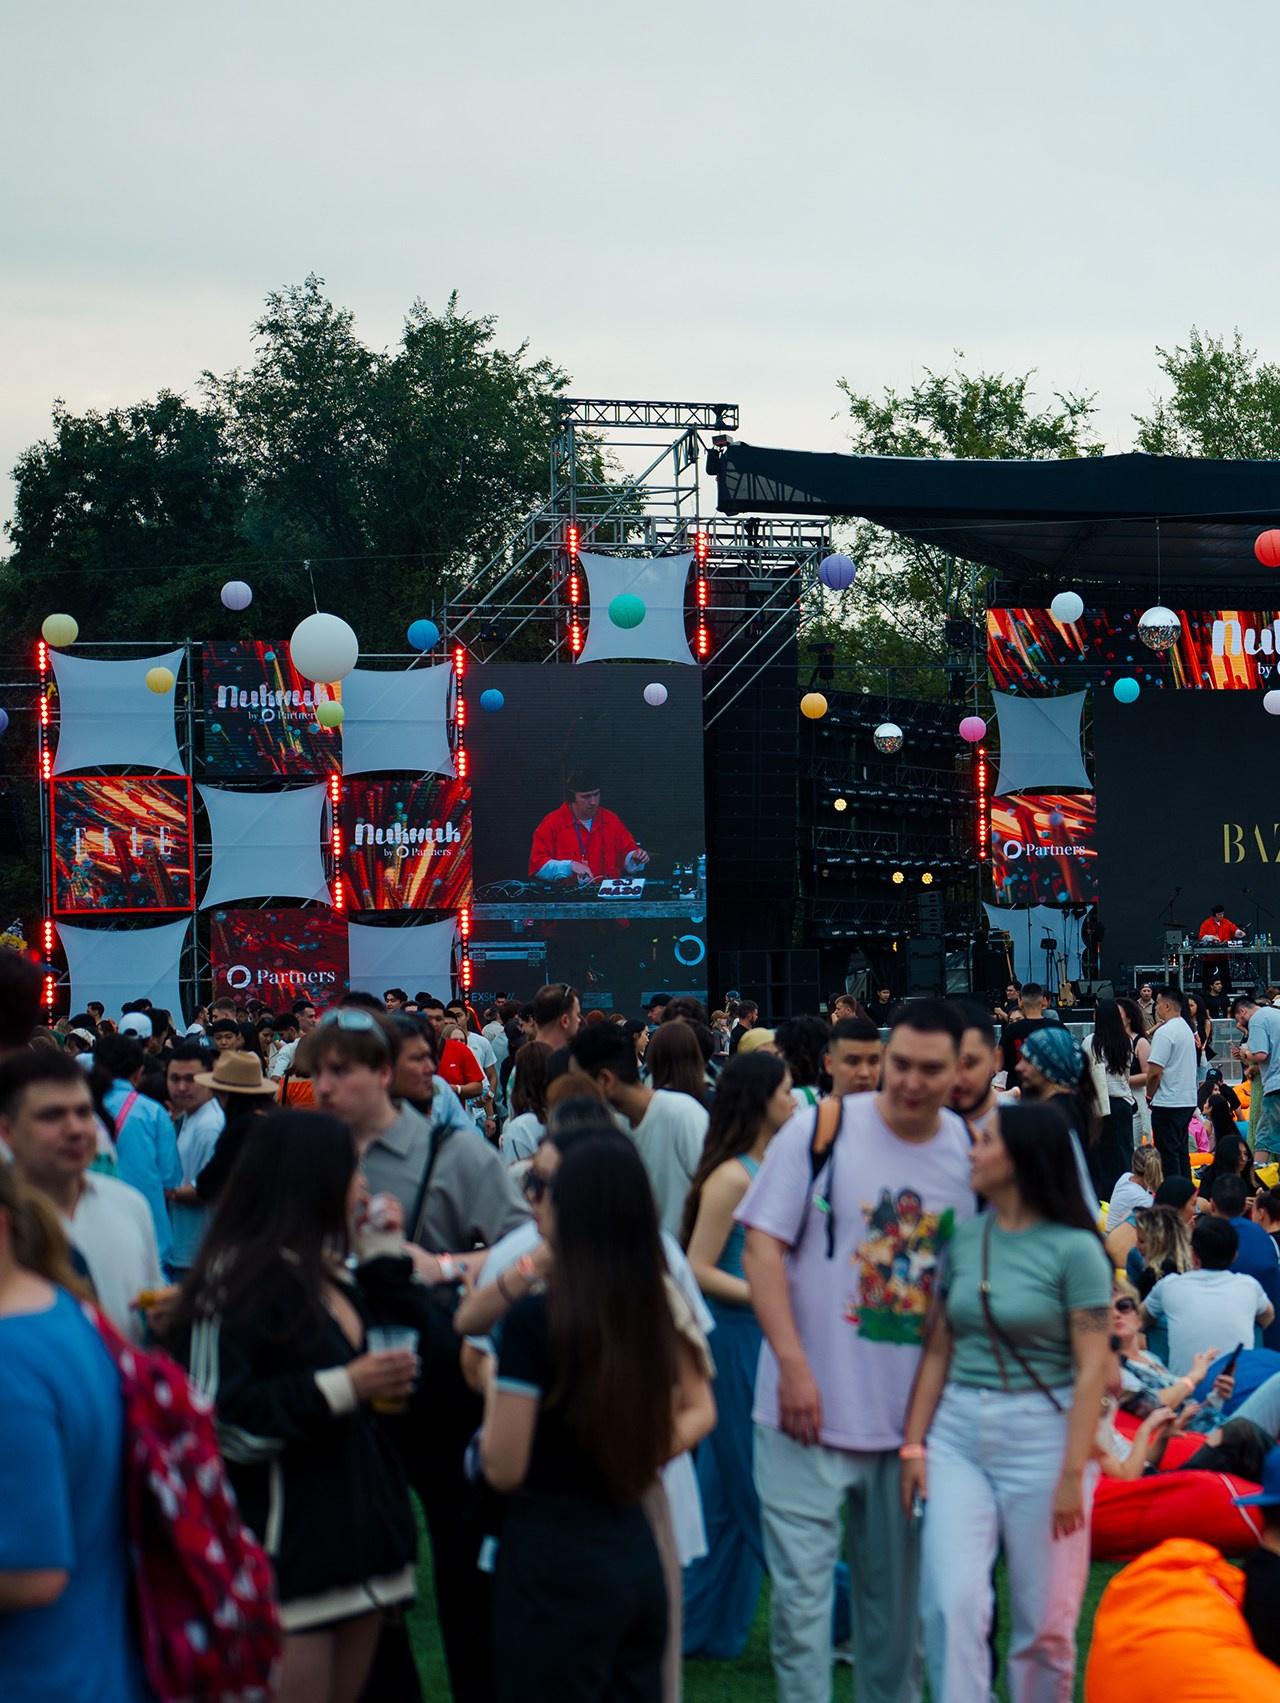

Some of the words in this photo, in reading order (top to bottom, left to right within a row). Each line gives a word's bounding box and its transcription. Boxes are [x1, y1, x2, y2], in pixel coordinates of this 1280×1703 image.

[1258, 663, 1272, 677] by
[248, 711, 259, 720] by
[278, 711, 316, 720] Partner
[75, 826, 172, 856] ELLE
[384, 848, 393, 858] by
[411, 848, 452, 856] Partners
[1026, 844, 1086, 856] Partners
[257, 968, 336, 985] Partners
[471, 992, 515, 1002] EXSHW
